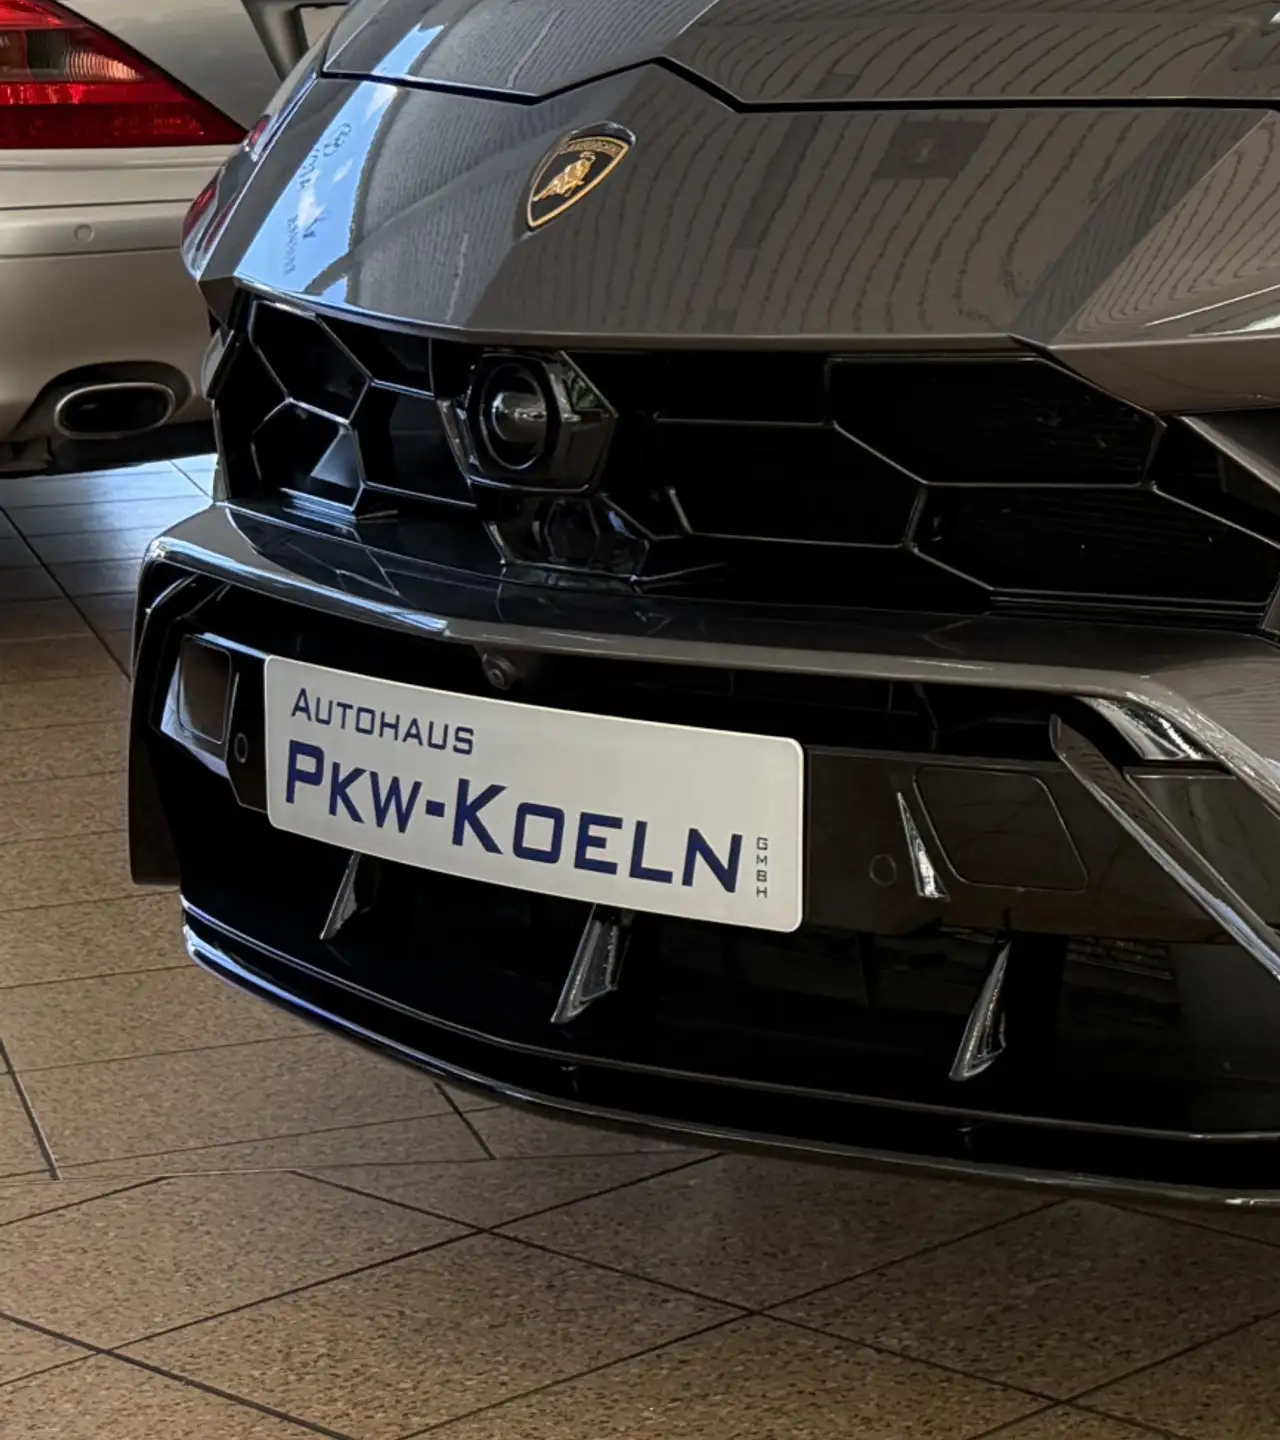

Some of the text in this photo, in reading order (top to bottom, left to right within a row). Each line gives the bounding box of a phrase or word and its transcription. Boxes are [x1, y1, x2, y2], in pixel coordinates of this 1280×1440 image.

[291, 687, 475, 755] AUTOHAUS
[284, 739, 743, 894] PKW-KOELN
[755, 835, 769, 900] GMBH
